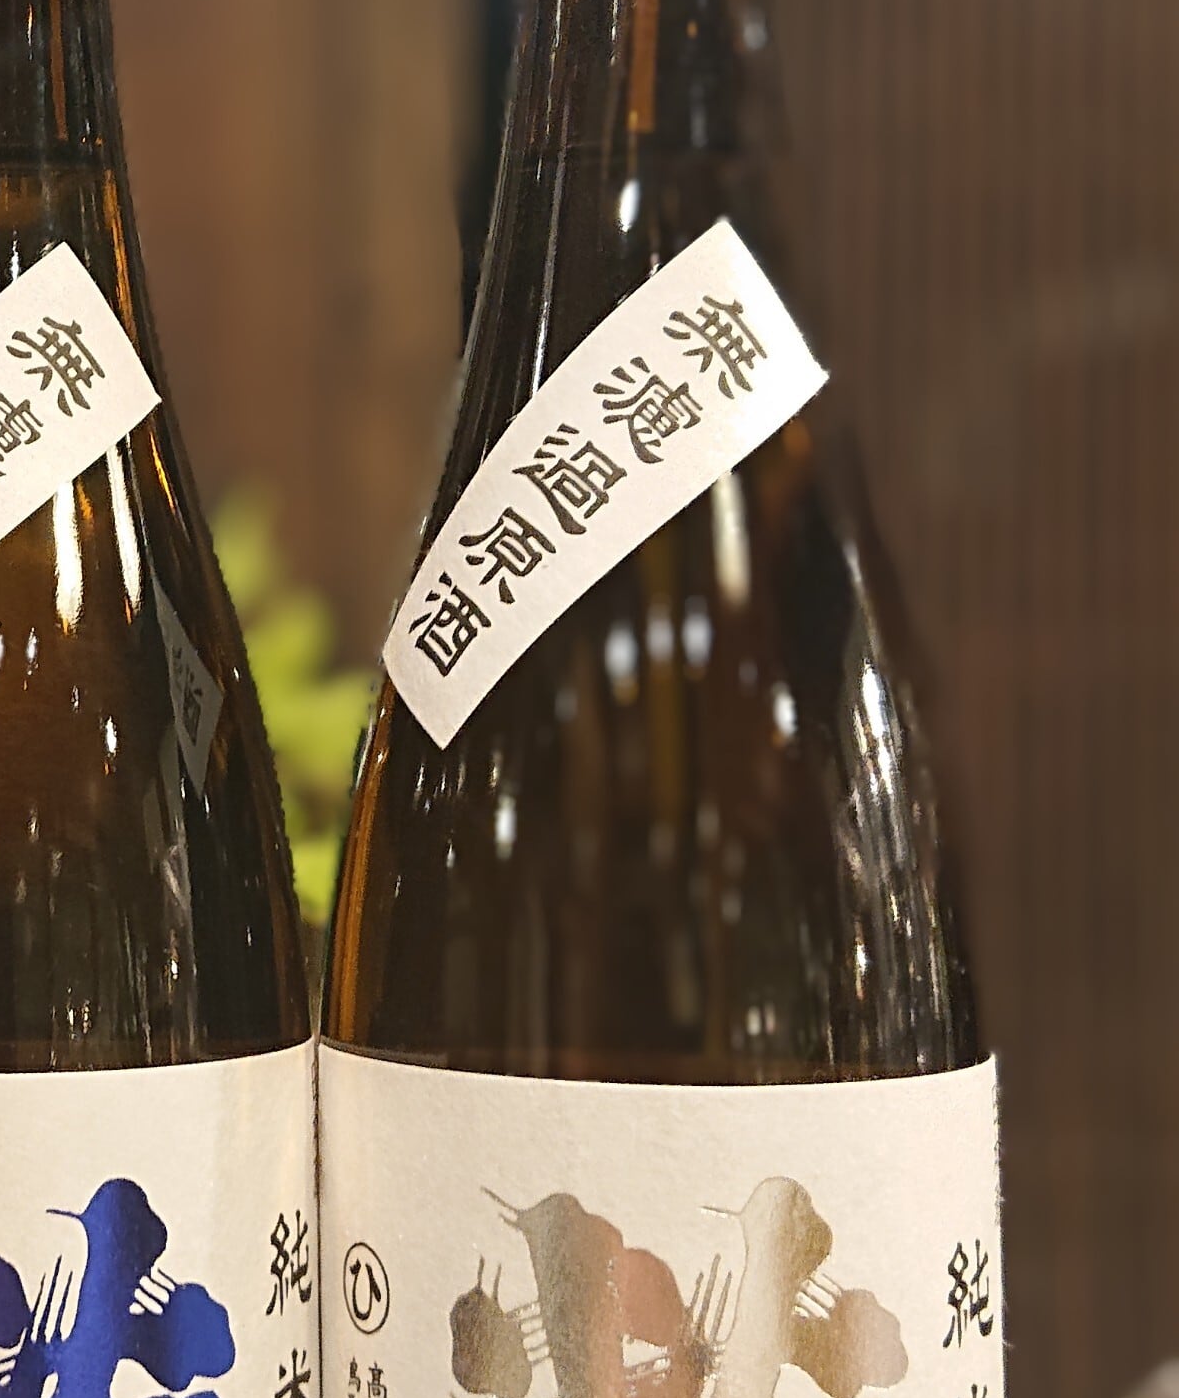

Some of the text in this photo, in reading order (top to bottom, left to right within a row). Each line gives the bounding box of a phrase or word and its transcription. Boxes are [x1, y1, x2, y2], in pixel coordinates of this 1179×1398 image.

[408, 294, 768, 678] 無濾過原酒
